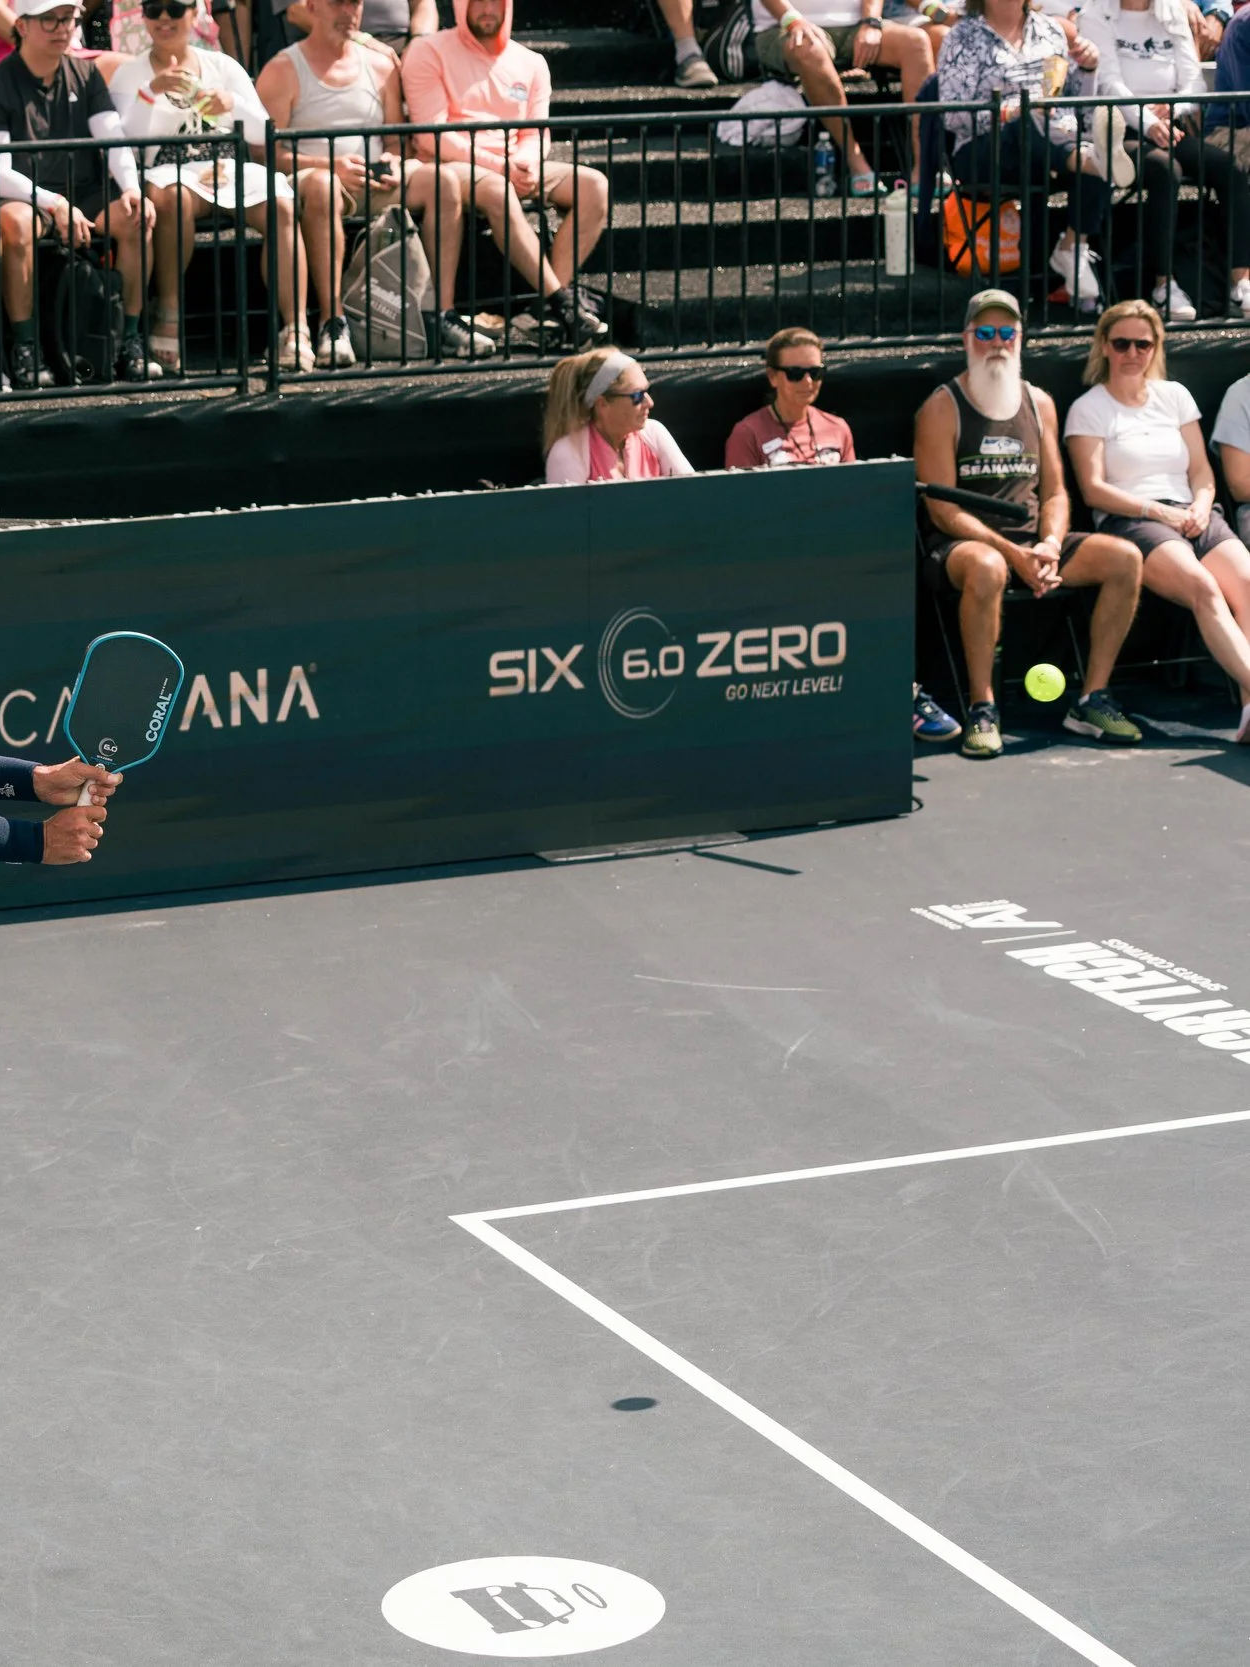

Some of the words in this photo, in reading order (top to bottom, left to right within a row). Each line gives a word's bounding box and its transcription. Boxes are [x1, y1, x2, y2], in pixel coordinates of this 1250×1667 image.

[959, 464, 1038, 477] SEAHAWKS
[489, 644, 585, 696] SIX
[622, 645, 685, 680] 6.0
[696, 621, 847, 678] ZERO
[725, 684, 748, 701] GO
[751, 680, 791, 699] NEXT
[792, 675, 843, 696] LEVEL!
[145, 693, 173, 742] CORAL
[1167, 967, 1229, 992] SPORTS
